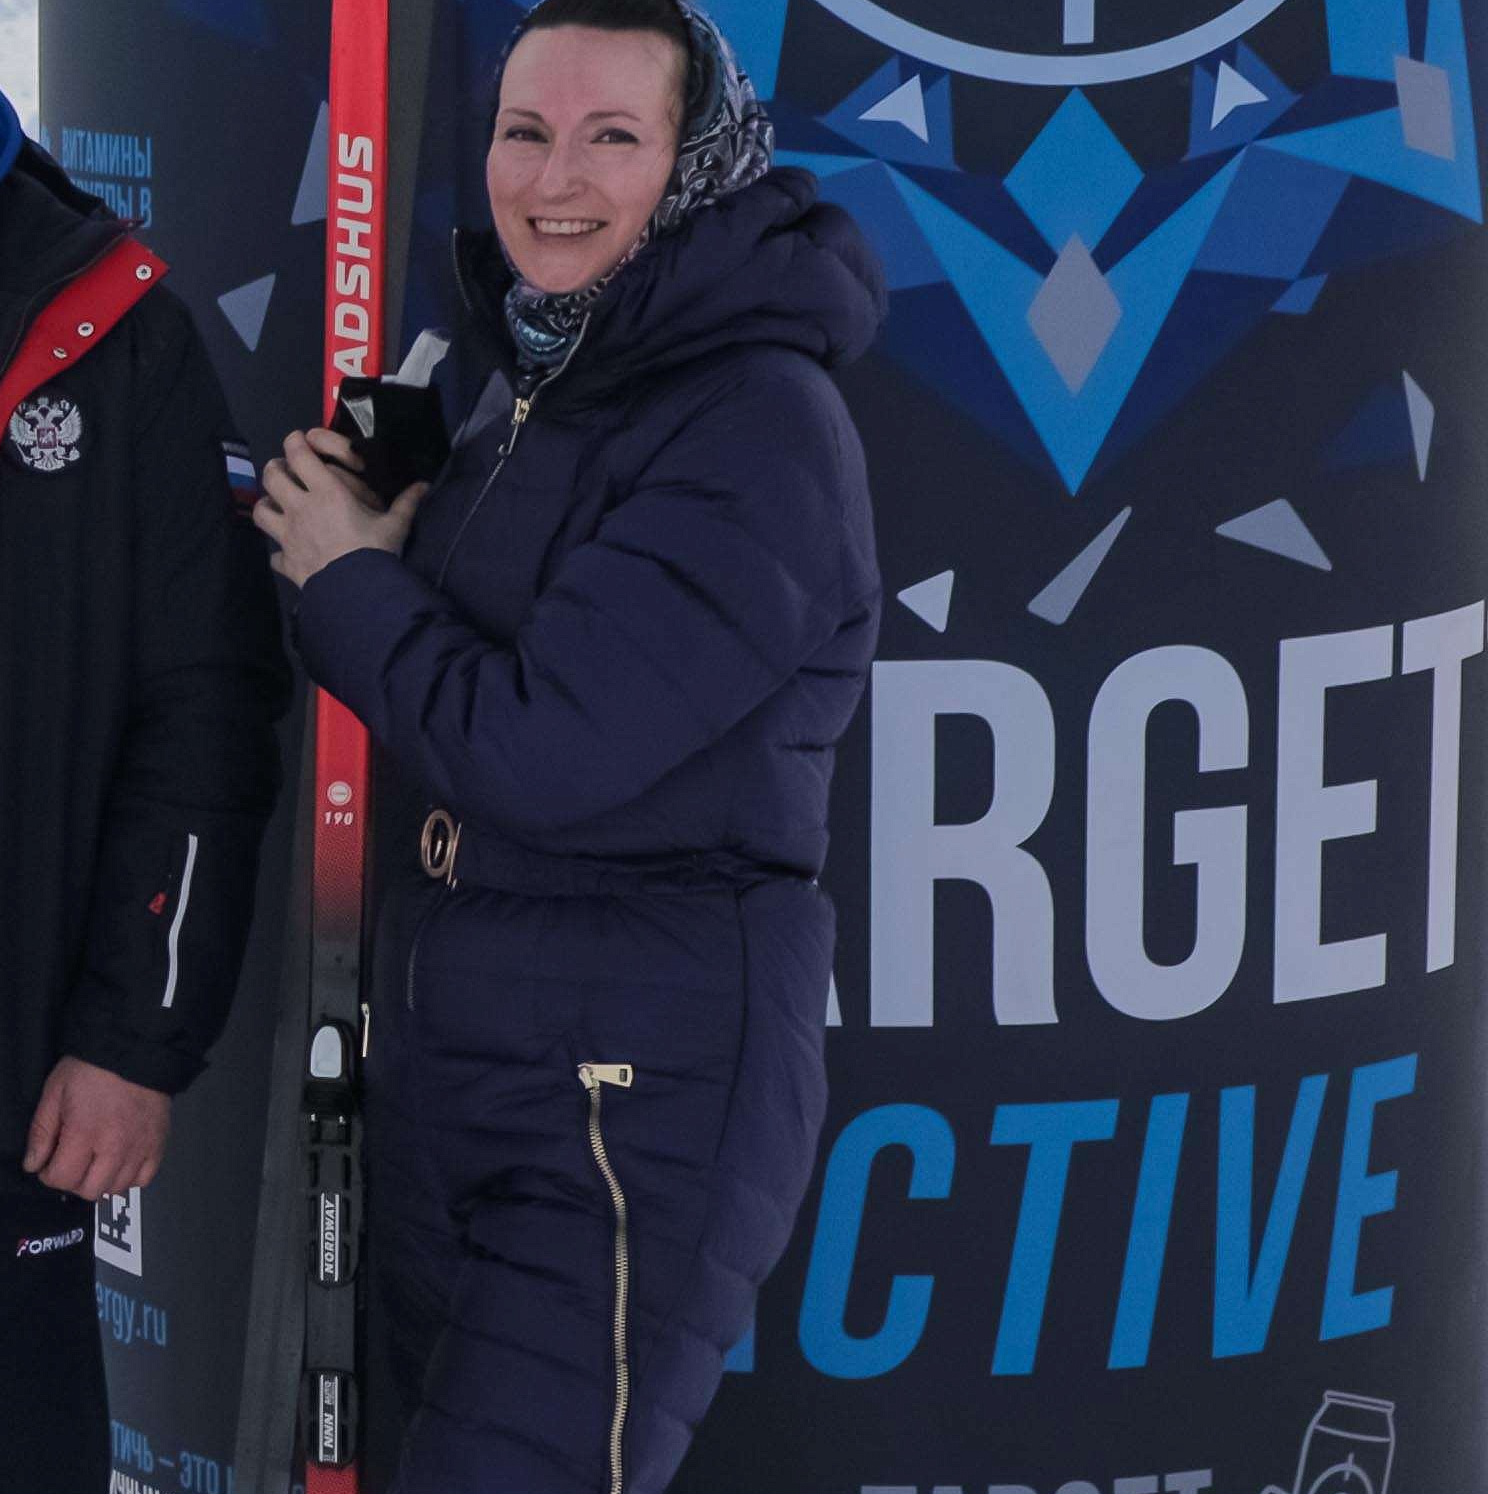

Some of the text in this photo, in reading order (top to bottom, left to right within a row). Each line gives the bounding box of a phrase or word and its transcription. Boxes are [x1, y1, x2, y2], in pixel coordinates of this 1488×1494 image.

[62, 127, 152, 179] ВИТАМИНЫ
[333, 133, 374, 395] ADSHUS
[325, 810, 354, 826] 190
[828, 600, 1486, 1028] RGET
[16, 1227, 85, 1257] FORWARD
[324, 1199, 336, 1274] NORDWAY
[786, 1053, 1418, 1378] CTIVE
[96, 1280, 166, 1346] ergy.ru
[111, 1419, 153, 1473] ТИЧЬ
[323, 1412, 335, 1449] NNN
